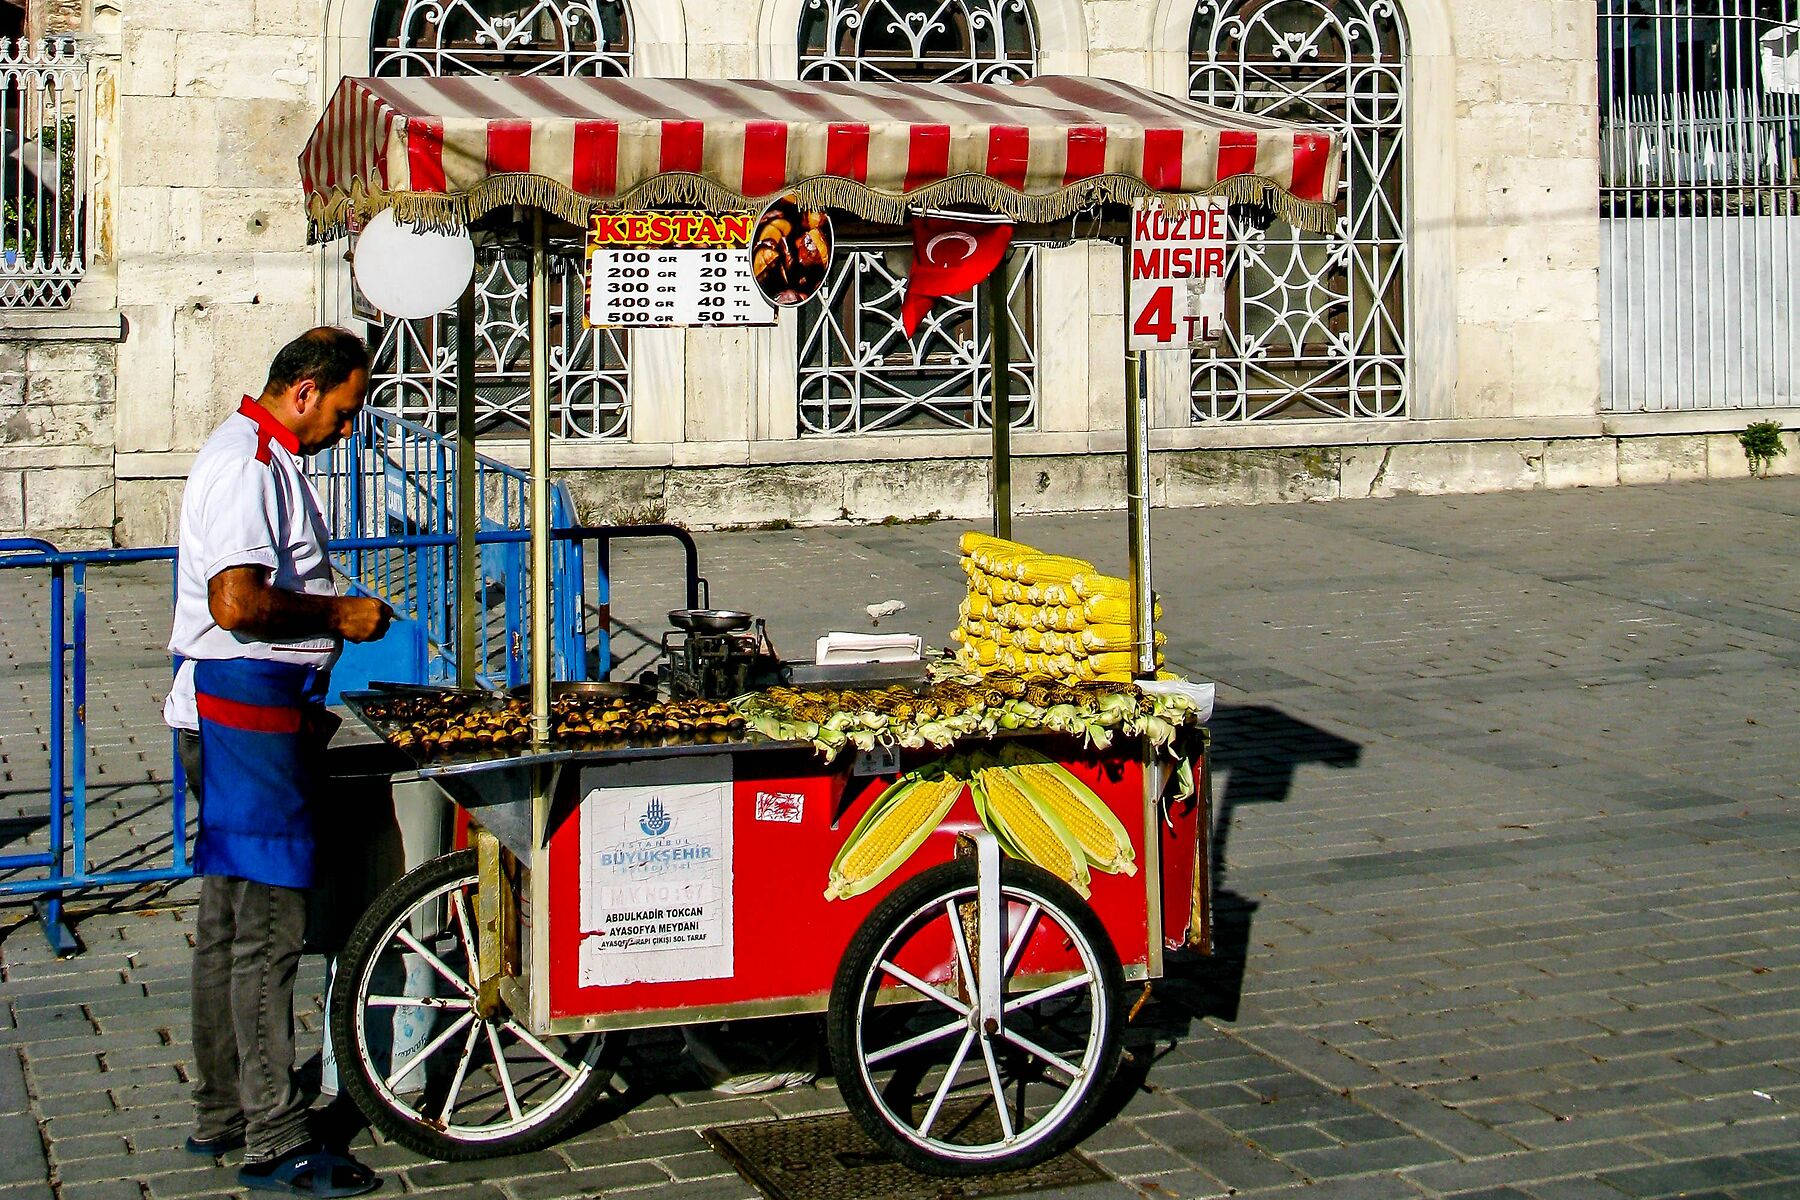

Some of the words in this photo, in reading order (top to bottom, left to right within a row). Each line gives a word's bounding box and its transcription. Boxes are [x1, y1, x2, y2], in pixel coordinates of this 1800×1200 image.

[596, 216, 751, 243] KESTAN
[609, 253, 650, 263] 100
[701, 252, 728, 263] 10
[1133, 247, 1224, 280] MISIR
[607, 267, 650, 278] 200
[699, 267, 727, 277] 20
[607, 282, 649, 293] 300
[699, 282, 727, 292] 30
[607, 297, 650, 307] 400
[697, 296, 725, 307] 40
[607, 312, 650, 322] 500
[697, 311, 725, 321] 50
[1133, 286, 1177, 342] 4
[1183, 316, 1219, 341] TL
[605, 908, 664, 923] ABDULKADİR
[666, 906, 703, 918] TOKCAN
[609, 924, 656, 937] AYASOFYA
[659, 921, 699, 933] MEYDANI
[601, 938, 635, 948] AYASOF
[673, 935, 685, 943] SOL
[687, 933, 707, 941] TARAF
